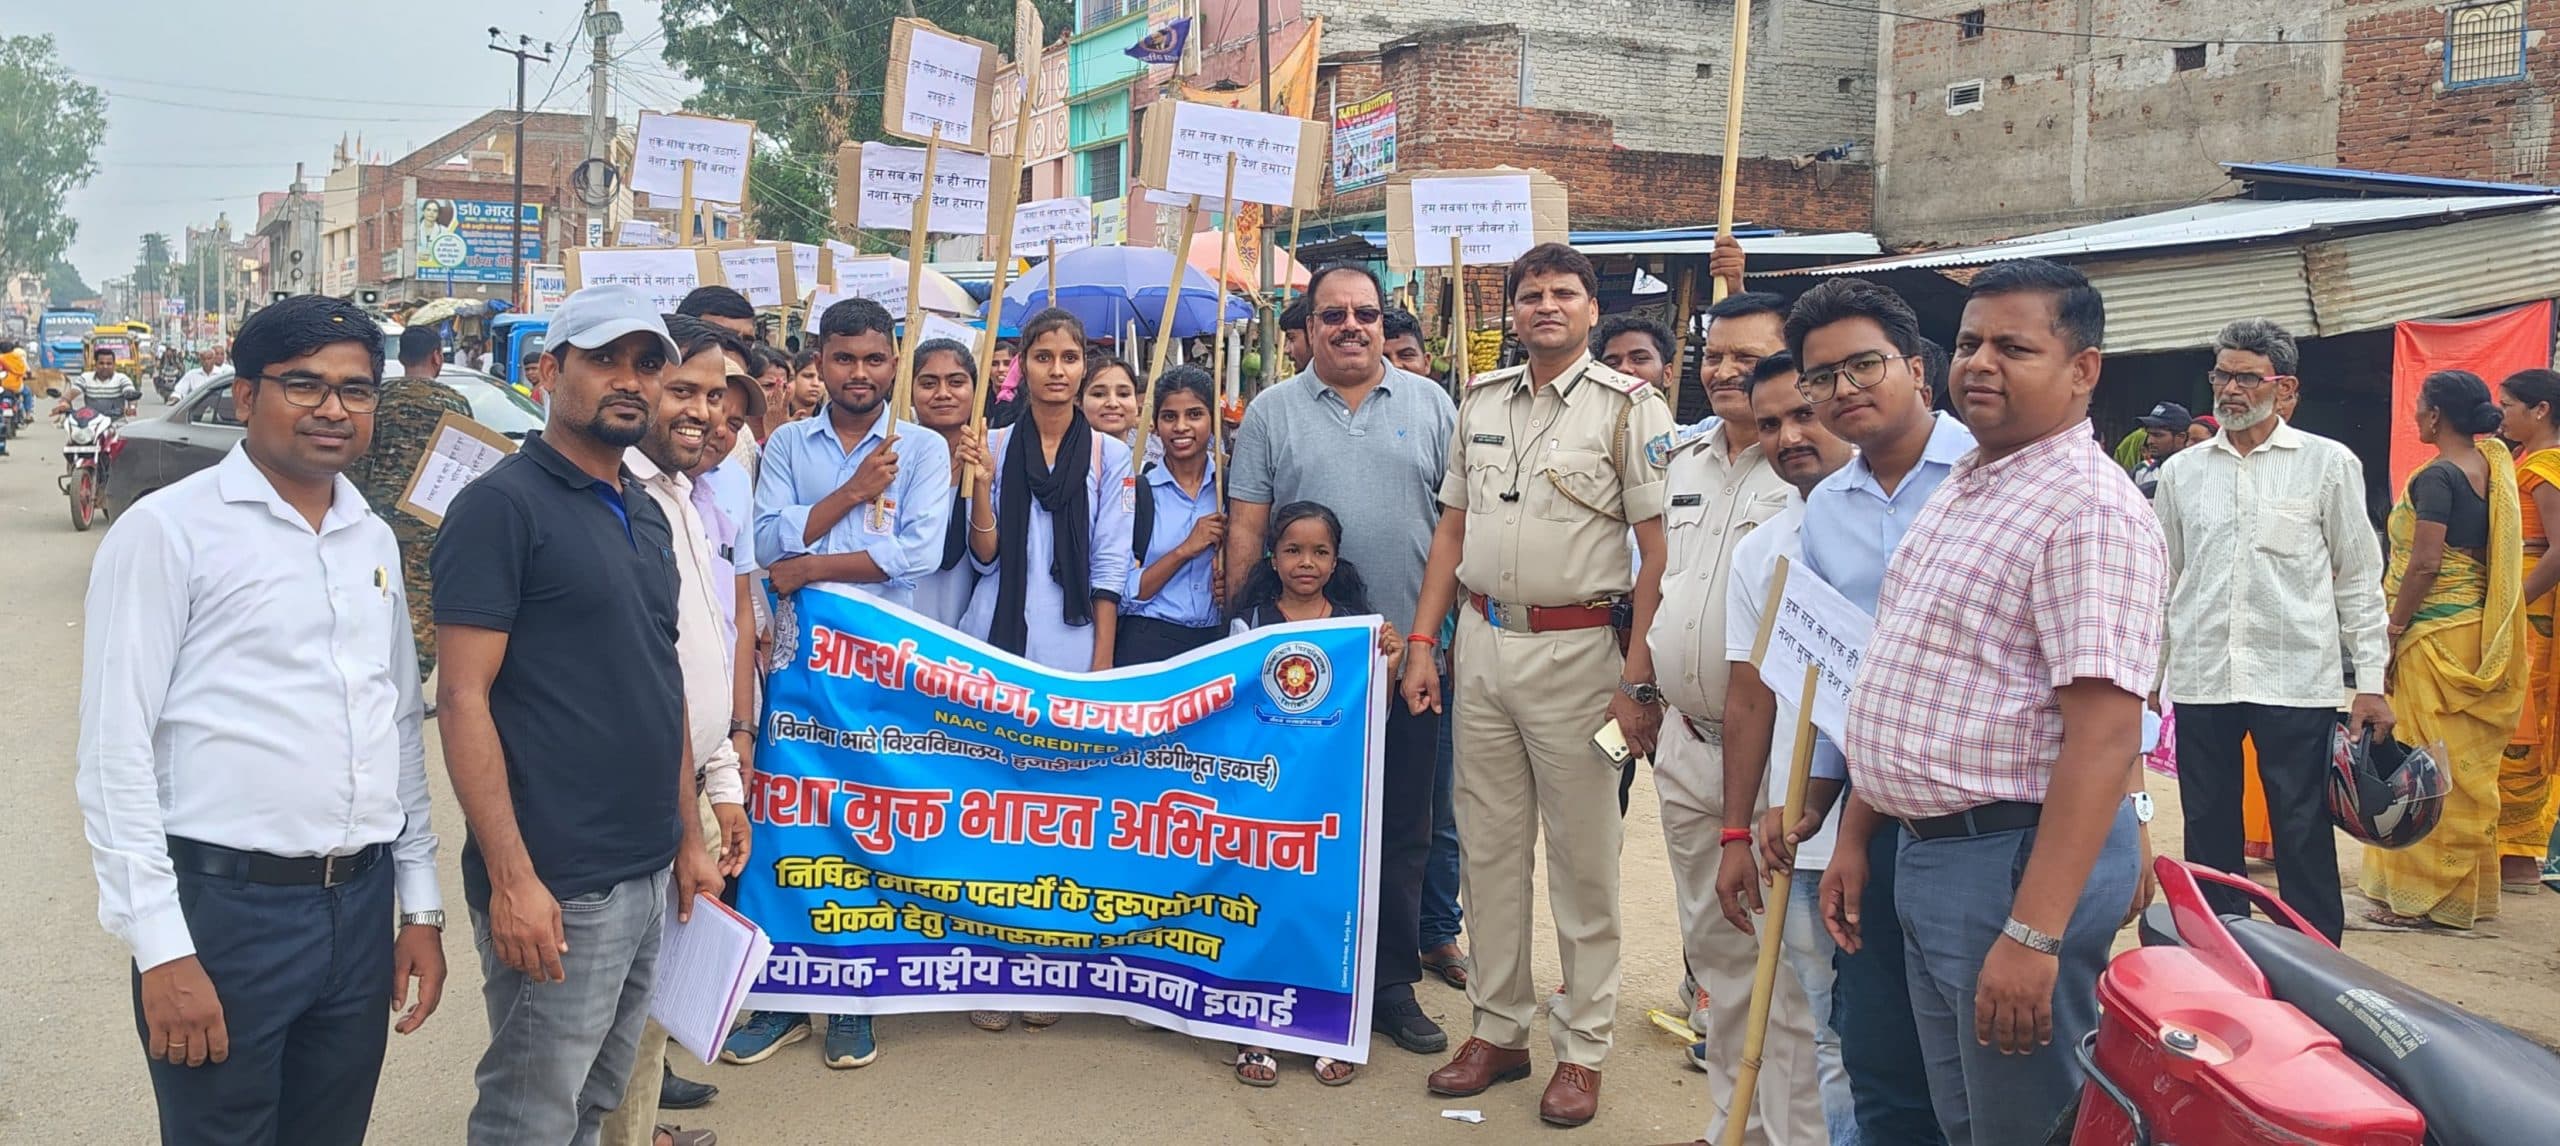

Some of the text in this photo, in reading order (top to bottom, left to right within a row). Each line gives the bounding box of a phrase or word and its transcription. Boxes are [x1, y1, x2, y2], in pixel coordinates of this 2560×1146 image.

[1179, 128, 1296, 156] हम सब का एक ही नारा
[1177, 149, 1199, 161] नशा
[1202, 152, 1224, 166] मुक्त
[1240, 155, 1258, 170] देश
[1260, 161, 1292, 176] हमारा
[868, 167, 883, 184] हम
[888, 169, 905, 182] सब
[909, 172, 922, 185] का
[947, 172, 960, 188] ही
[963, 177, 988, 189] नारा
[867, 188, 888, 201] नशा
[892, 192, 913, 205] मुक्त
[932, 194, 949, 208] देश
[952, 197, 985, 212] हमारा
[1420, 202, 1436, 216] हम
[1471, 202, 1488, 216] एक
[1491, 199, 1502, 215] ही
[1505, 201, 1528, 213] नारा
[1431, 220, 1520, 239] नशा मुक्त जीवन हो
[1461, 243, 1492, 256] हमारा
[590, 272, 618, 286] अपनी
[643, 272, 651, 287] में
[655, 275, 675, 286] नशा
[45, 316, 93, 325] SHIVAM
[1785, 596, 1860, 673] हम सब का एक ही
[1777, 625, 1797, 648] नशा
[1827, 665, 1843, 692] देश
[808, 625, 1236, 737] आदर्श कॉलेज, राजधनवार
[934, 709, 988, 732] NAAC
[768, 710, 836, 747] (विनोबा
[840, 726, 877, 751] भावे
[1143, 742, 1216, 785] अंगीभूत
[1218, 753, 1280, 792] इकाई)
[842, 780, 952, 855] मुक्त
[959, 788, 1102, 850] भारत
[1108, 789, 1340, 875] अभियान'
[776, 854, 871, 890] निषिद्ध
[874, 870, 961, 903] मादक
[966, 875, 1057, 910] पदार्थों
[1058, 878, 1091, 912] के
[1218, 893, 1260, 927] को
[811, 904, 1222, 961] रोकने हेतु जागरूकता अभियान
[897, 946, 1004, 992] राष्ट्रीय
[1009, 953, 1082, 989] सेवा
[1086, 956, 1199, 1012] योजना
[1202, 986, 1298, 1028] इकाई
